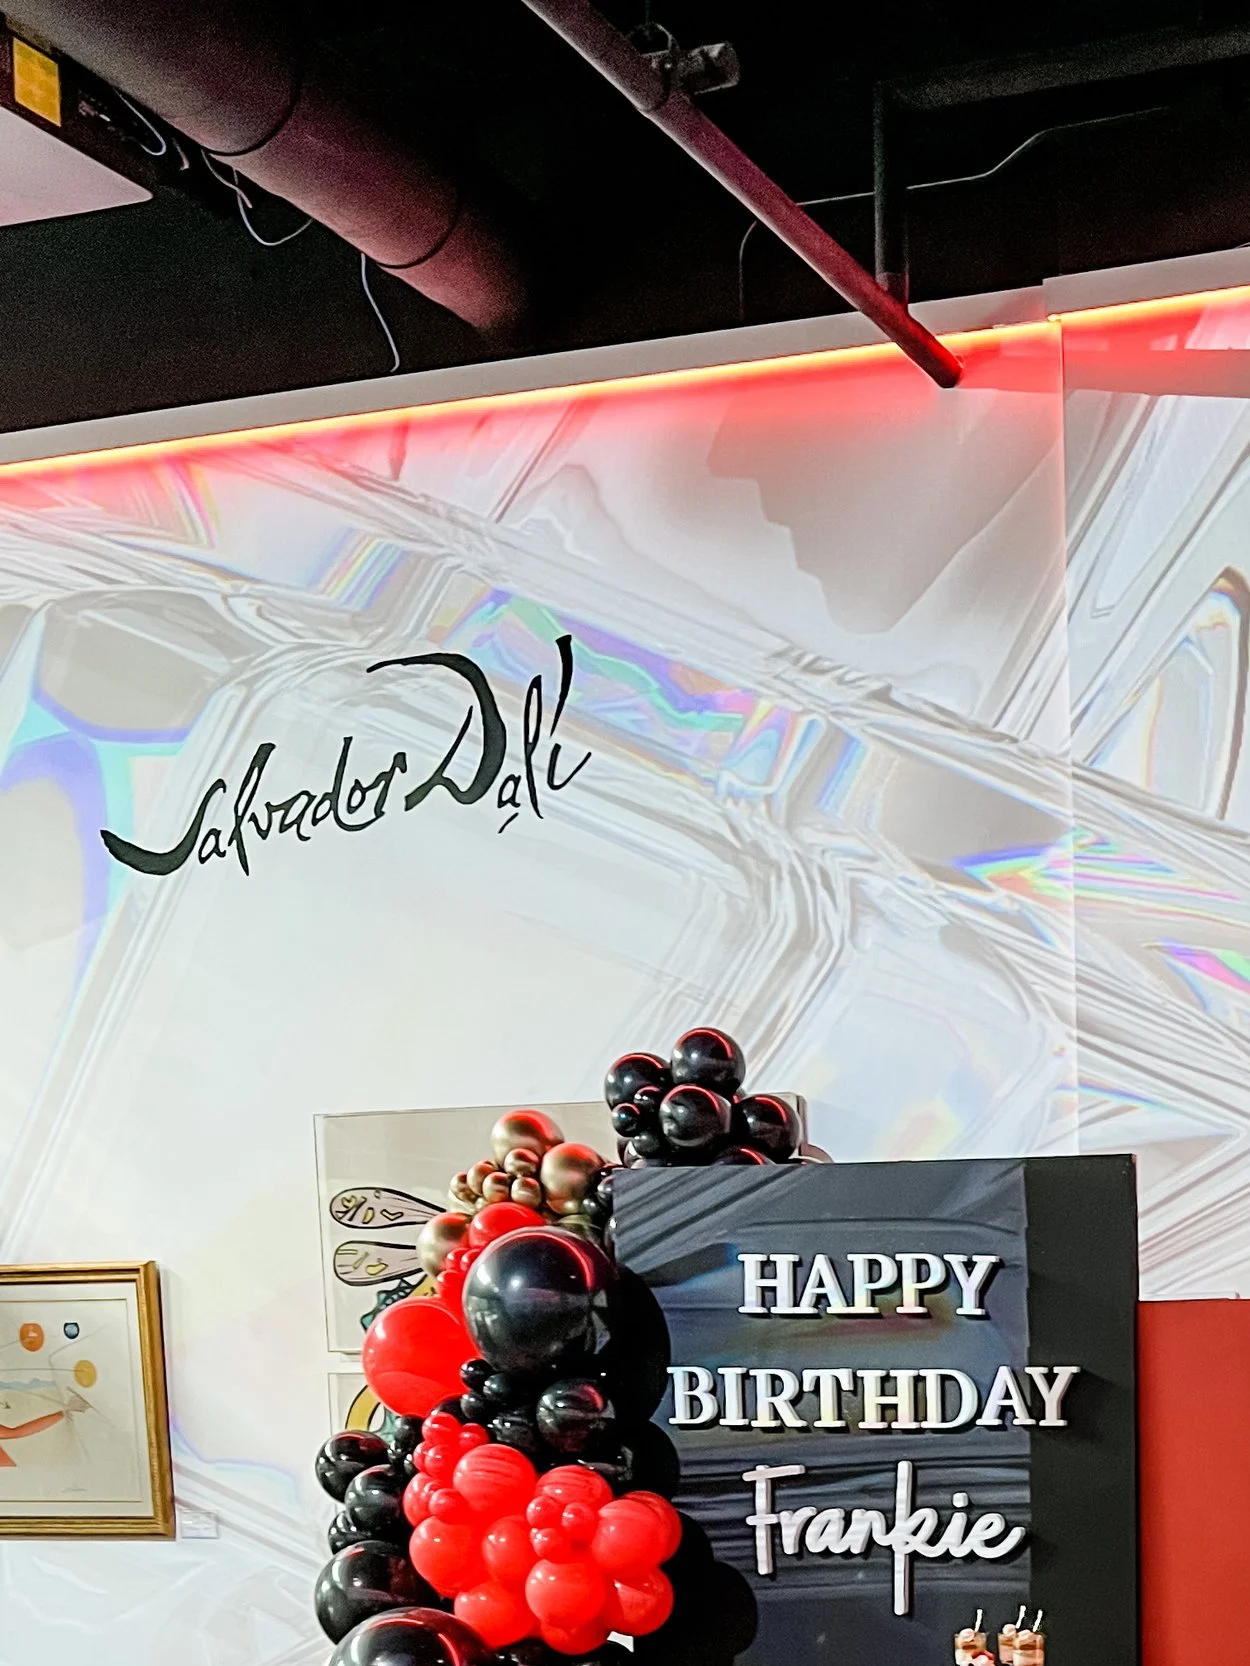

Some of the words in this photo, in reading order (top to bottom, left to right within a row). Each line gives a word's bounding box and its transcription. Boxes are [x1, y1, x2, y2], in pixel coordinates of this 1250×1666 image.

[100, 736, 407, 876] Salvador
[738, 1253, 1000, 1316] HAPPY
[667, 1365, 1081, 1429] BIRTHDAY
[742, 1460, 1026, 1616] Frankie
